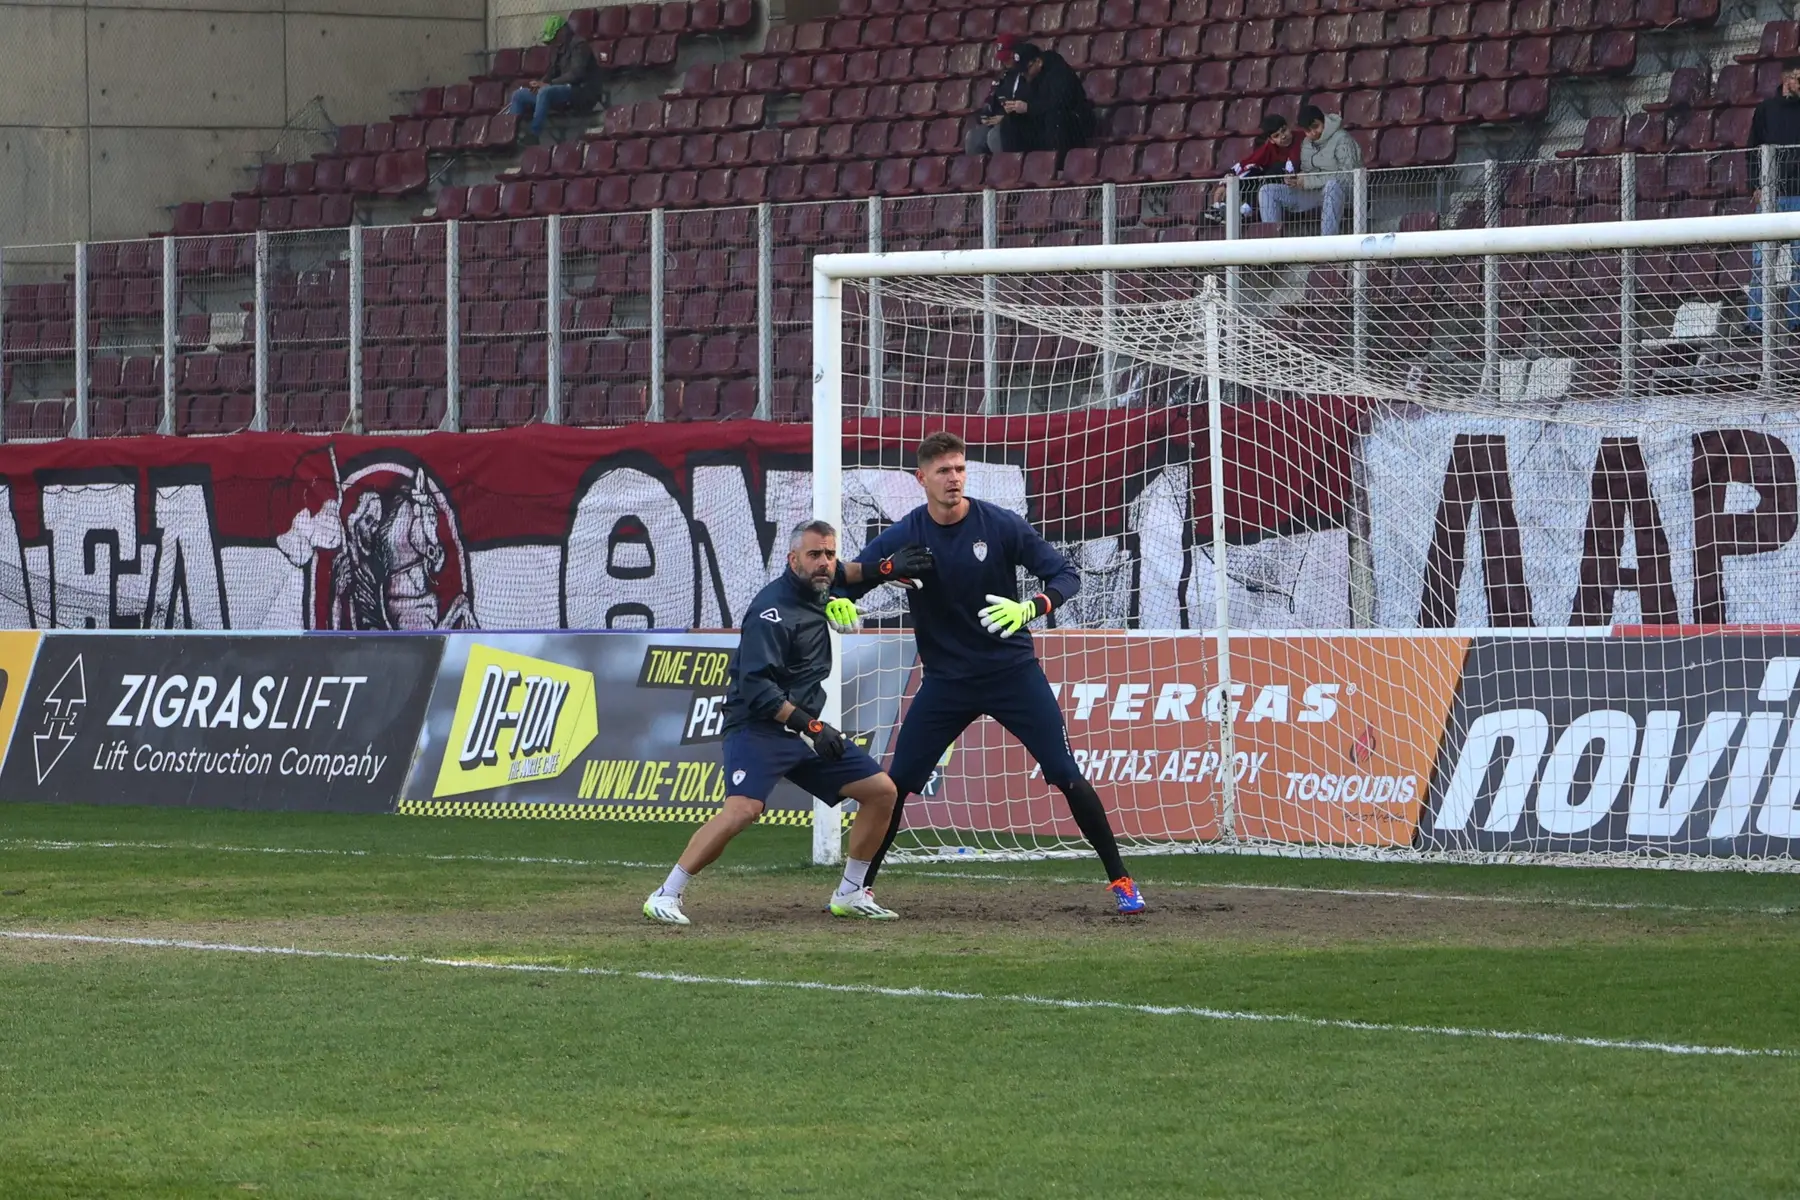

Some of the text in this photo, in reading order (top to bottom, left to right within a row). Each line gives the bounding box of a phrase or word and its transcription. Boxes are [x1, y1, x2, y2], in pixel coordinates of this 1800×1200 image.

[646, 650, 729, 686] TIME FOR
[106, 674, 368, 729] ZIGRASLIFT
[459, 664, 571, 768] DE-TOX
[93, 740, 387, 783] Lift Construction Company
[1286, 772, 1417, 804] TOSIOUDIS
